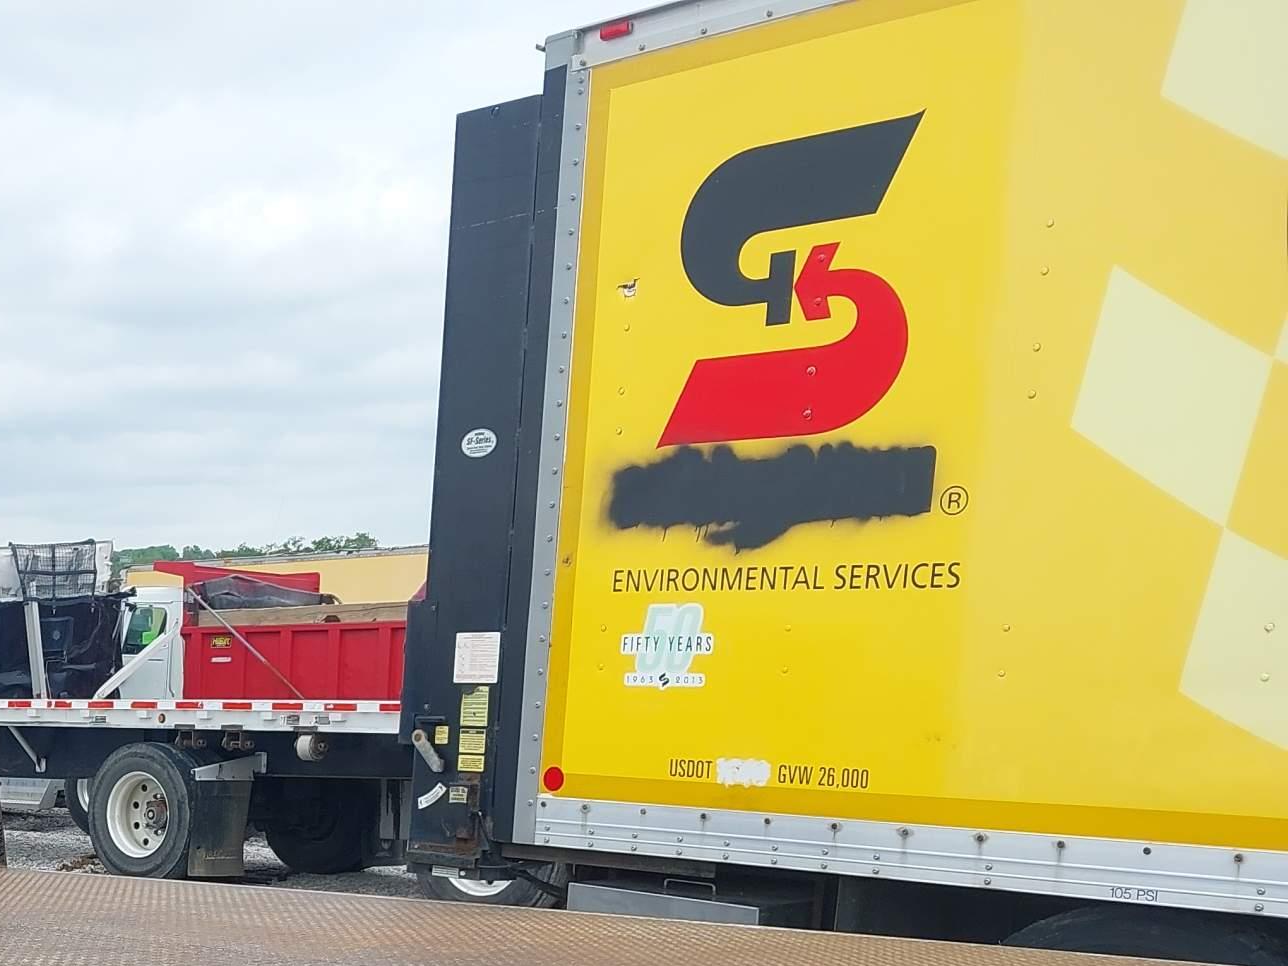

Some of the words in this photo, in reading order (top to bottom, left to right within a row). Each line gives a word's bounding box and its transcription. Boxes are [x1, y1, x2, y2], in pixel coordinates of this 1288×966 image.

[612, 566, 825, 593] ENVIRONMENTAL
[833, 562, 961, 590] SERVICES
[622, 636, 660, 652] FIFTY
[668, 636, 712, 652] YEARS
[626, 675, 654, 684] 1963
[675, 675, 704, 685] 2013
[669, 758, 713, 779] USDOT
[777, 764, 814, 785] GVW
[818, 766, 870, 789] 26,000
[1109, 886, 1132, 900] 105
[1136, 888, 1159, 903] PSI
